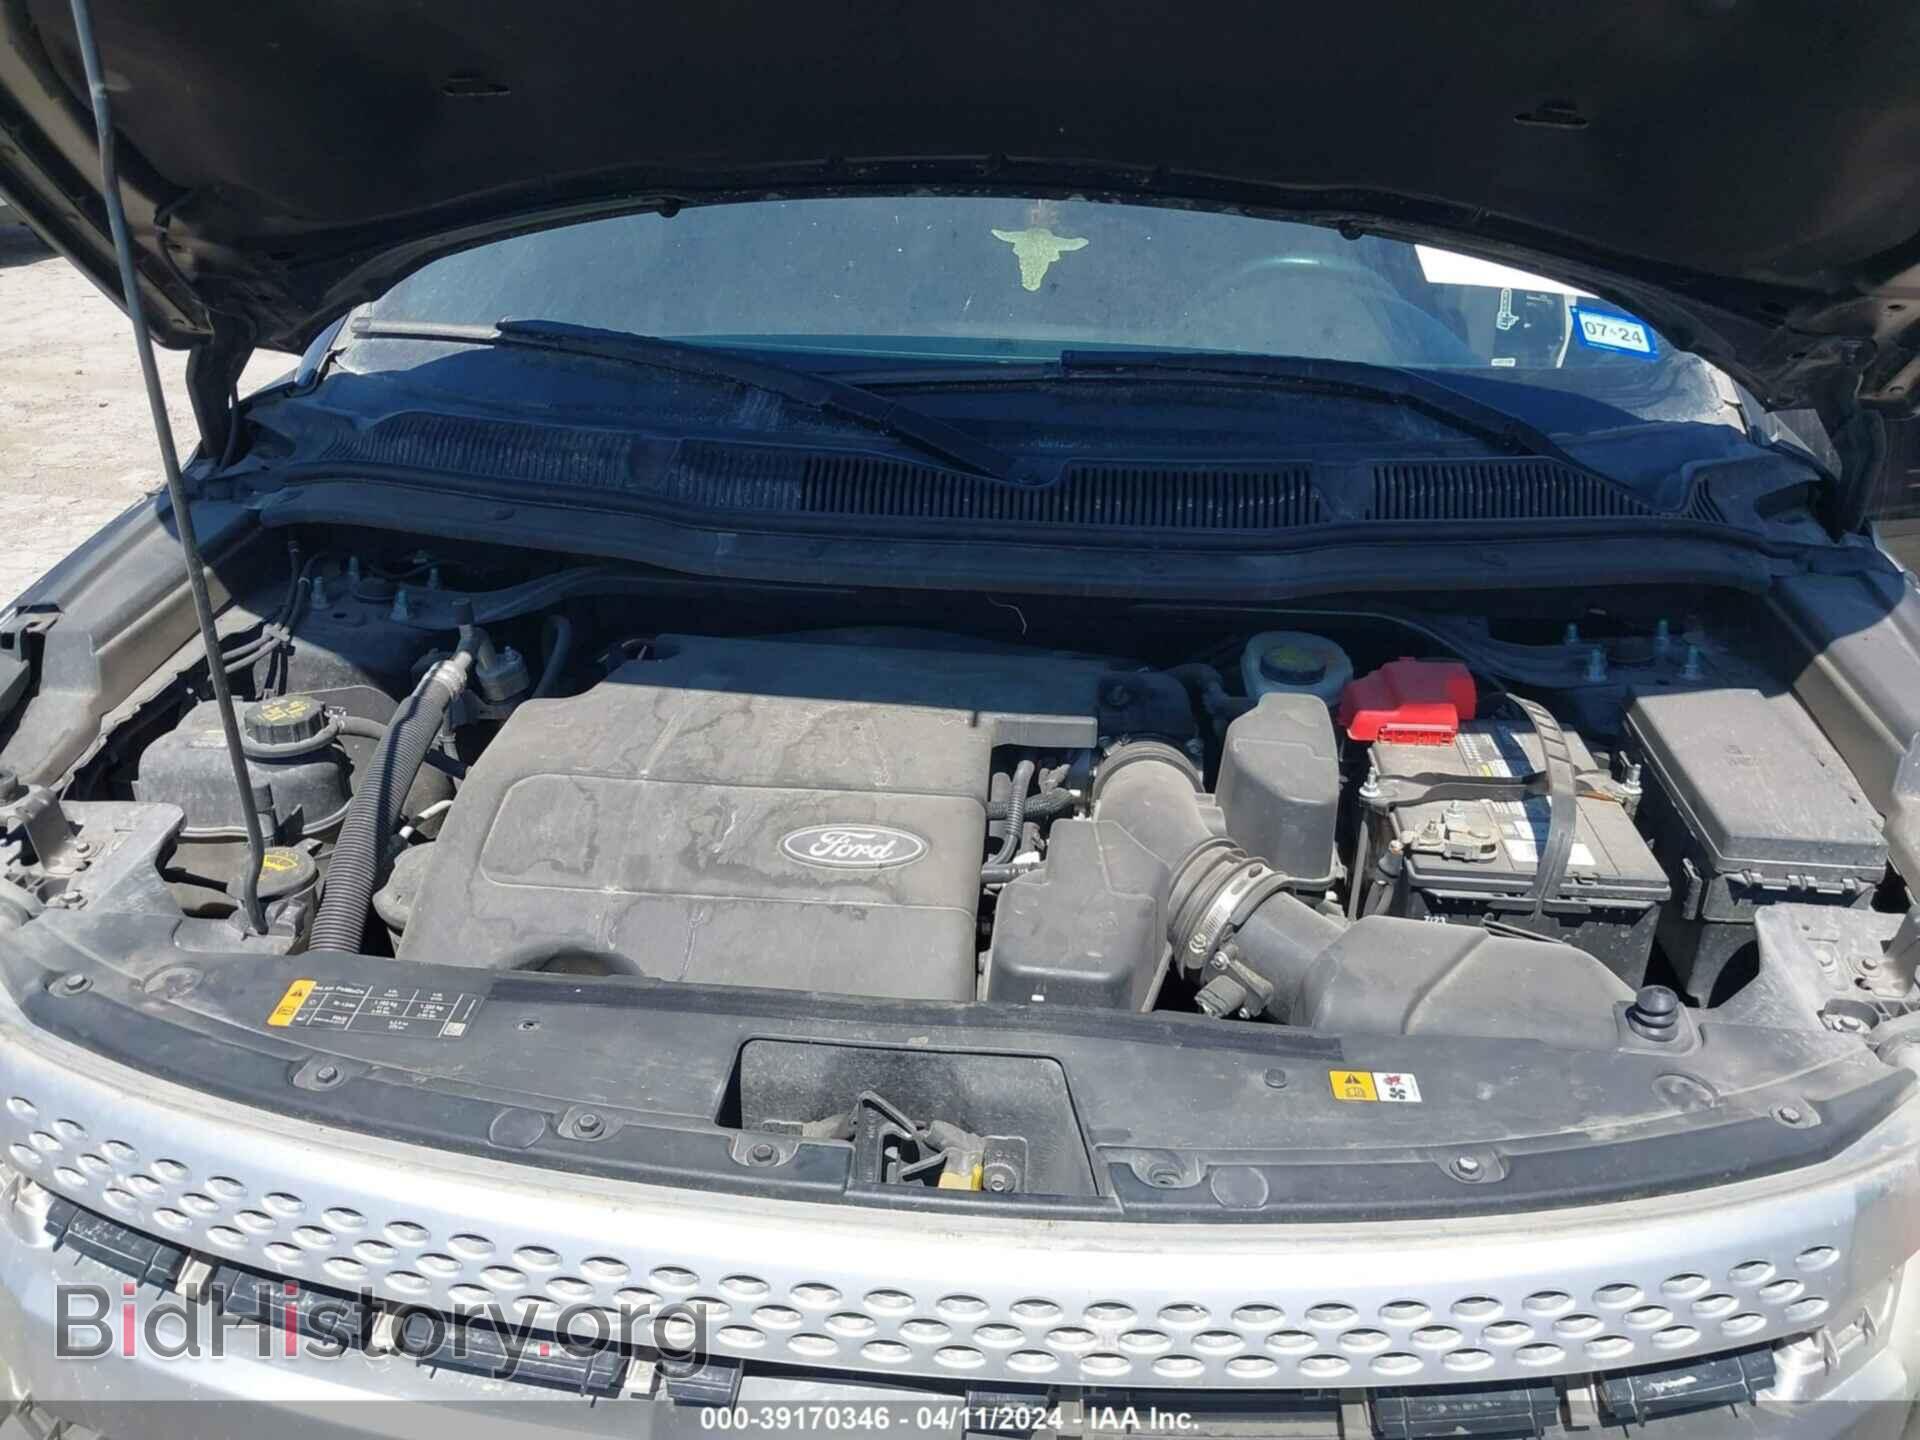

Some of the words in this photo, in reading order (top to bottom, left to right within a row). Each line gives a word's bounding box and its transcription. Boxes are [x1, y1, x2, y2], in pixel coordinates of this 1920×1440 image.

[1584, 320, 1607, 336] 07
[1618, 327, 1643, 345] 24
[809, 830, 896, 859] Ford
